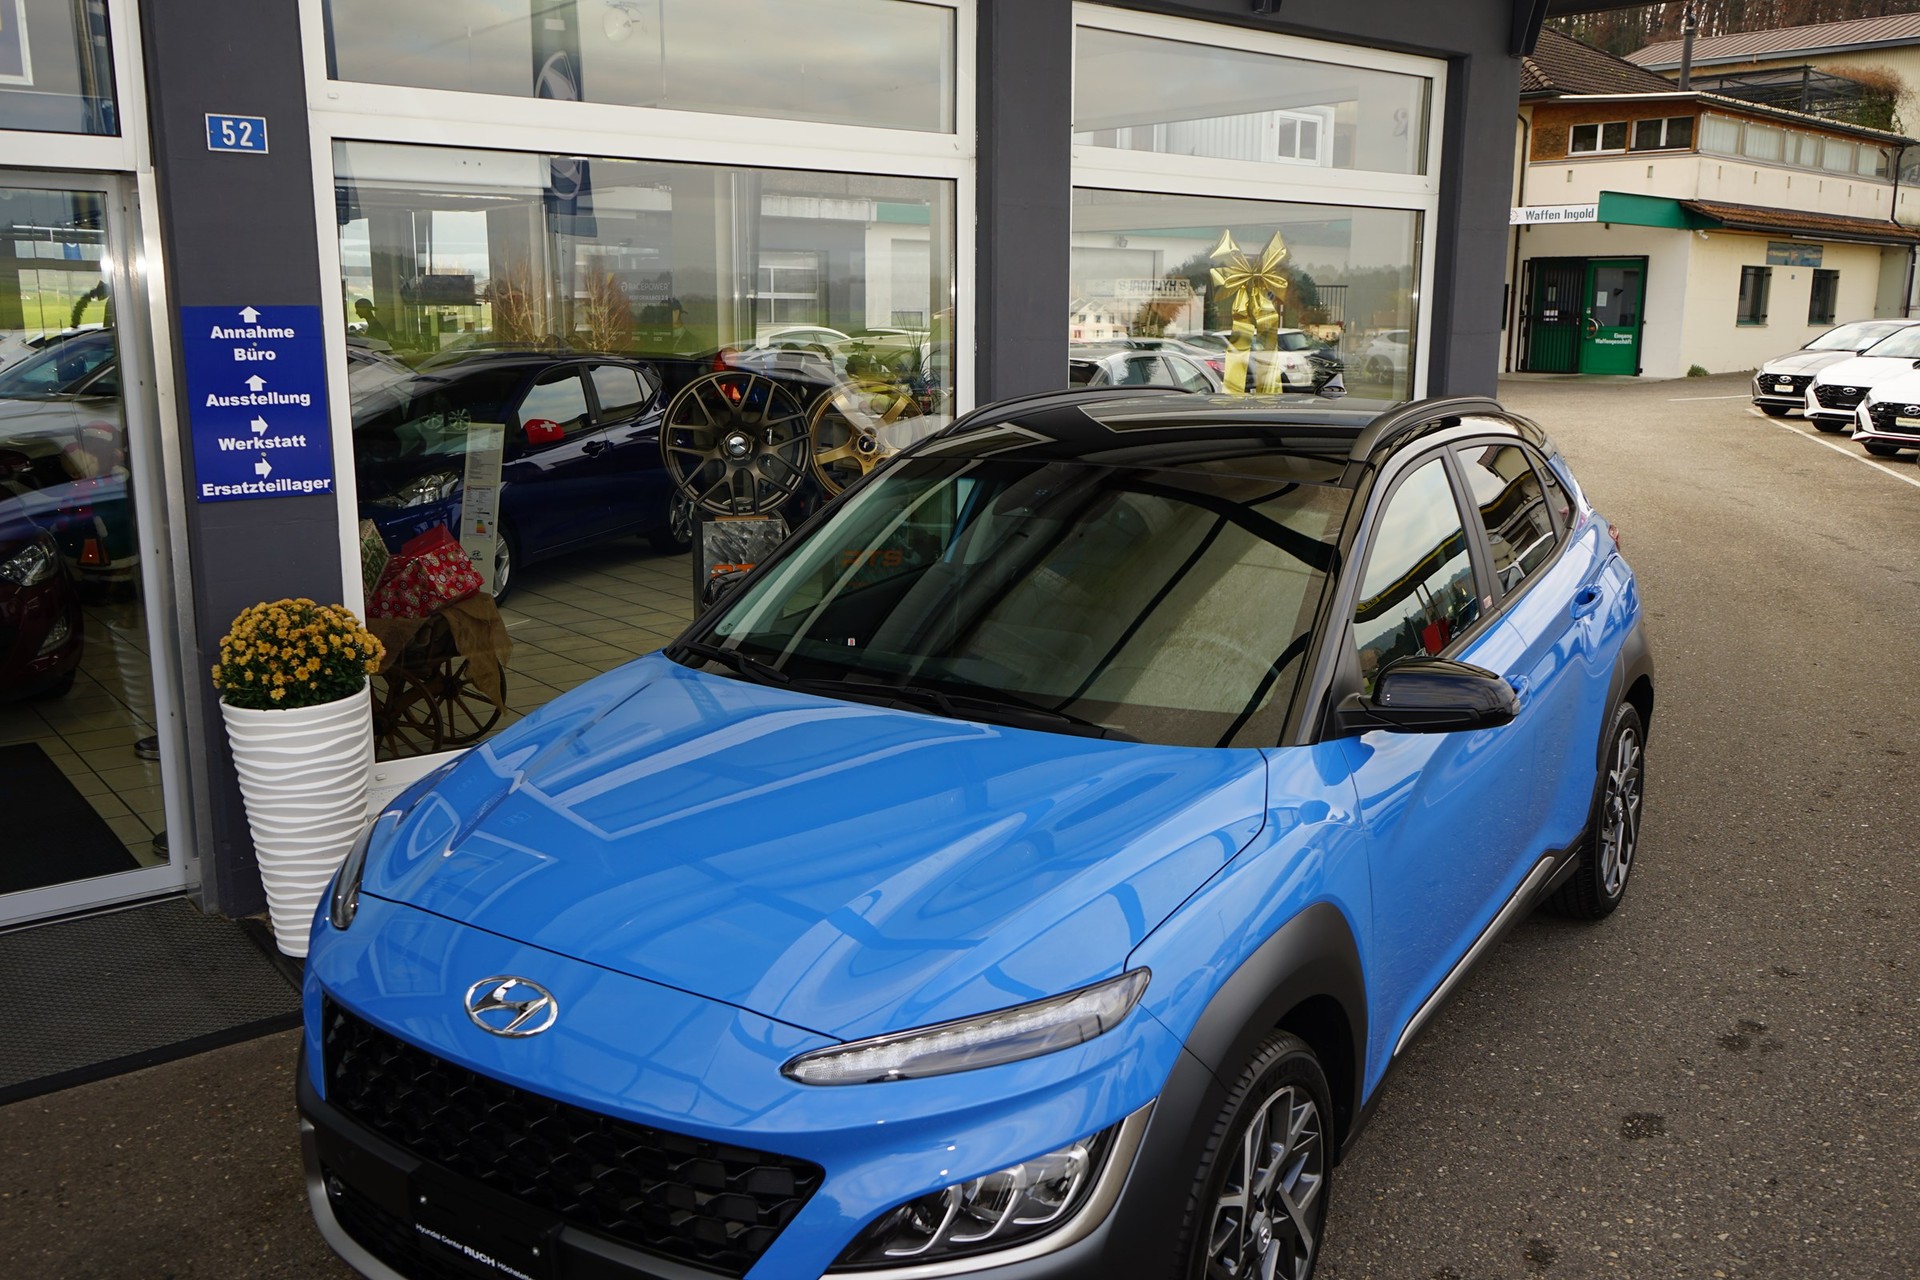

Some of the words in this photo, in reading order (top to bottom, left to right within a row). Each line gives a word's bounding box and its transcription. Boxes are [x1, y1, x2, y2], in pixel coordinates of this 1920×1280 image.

[221, 120, 254, 147] 52
[1525, 209, 1561, 221] Waffen
[1564, 208, 1595, 221] Ingold
[210, 326, 295, 339] Annahme
[233, 348, 276, 361] Büro
[205, 392, 311, 407] Ausstellung
[218, 434, 307, 451] Werkstatt
[202, 478, 331, 496] Ersatzteillager
[415, 1223, 441, 1241] Hyundai
[463, 1245, 496, 1268] RUCH
